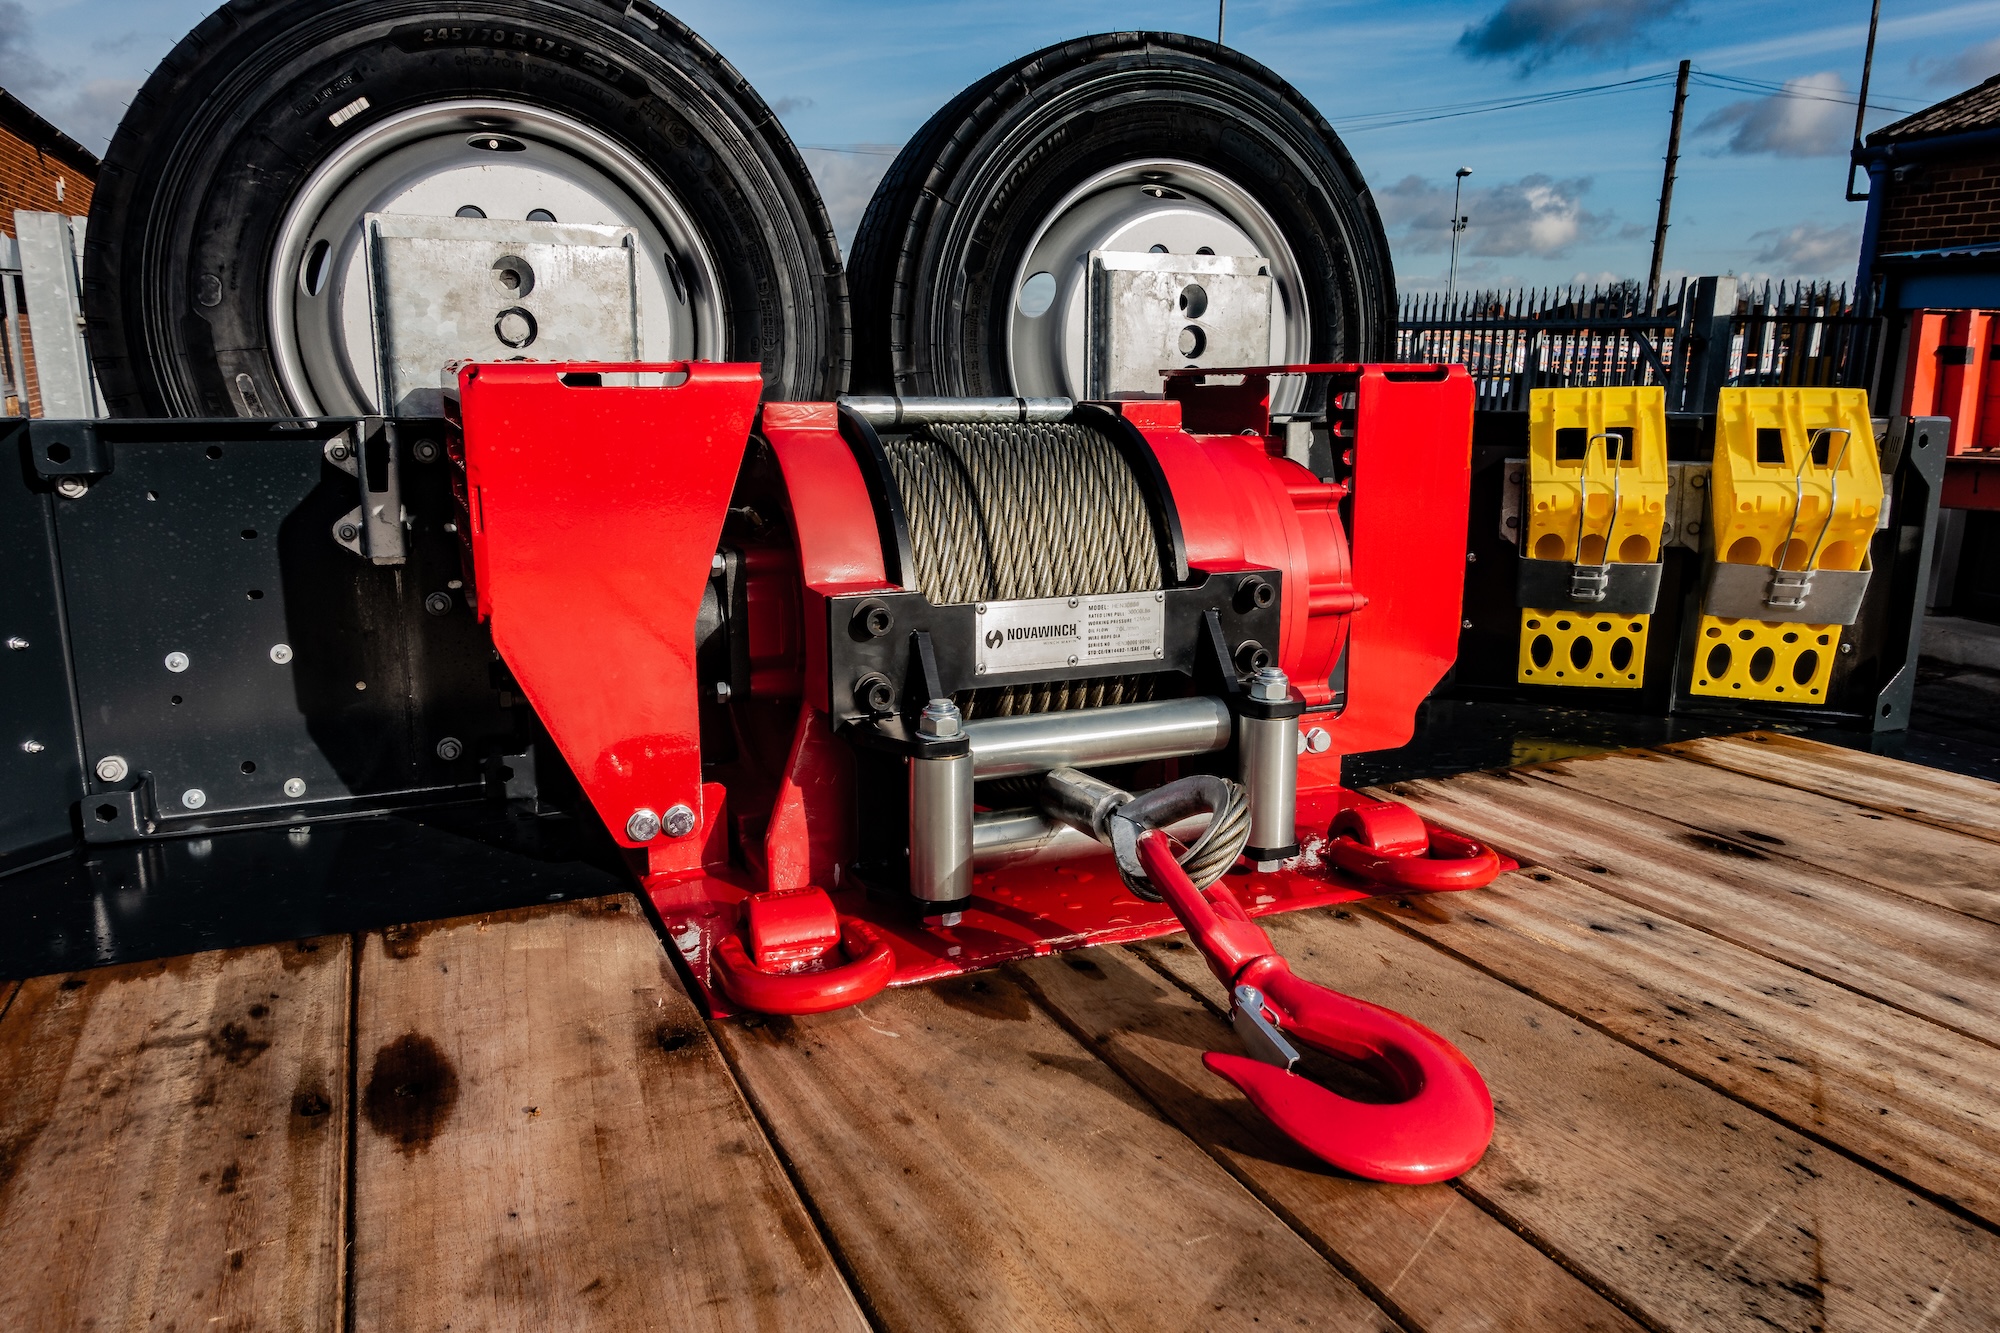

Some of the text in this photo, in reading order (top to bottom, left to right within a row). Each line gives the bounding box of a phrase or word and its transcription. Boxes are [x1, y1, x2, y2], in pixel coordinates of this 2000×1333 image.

[423, 27, 505, 42] 245/70
[512, 32, 528, 47] R
[992, 128, 1067, 214] MICHELIN
[1007, 623, 1077, 641] NOVAWINCH
